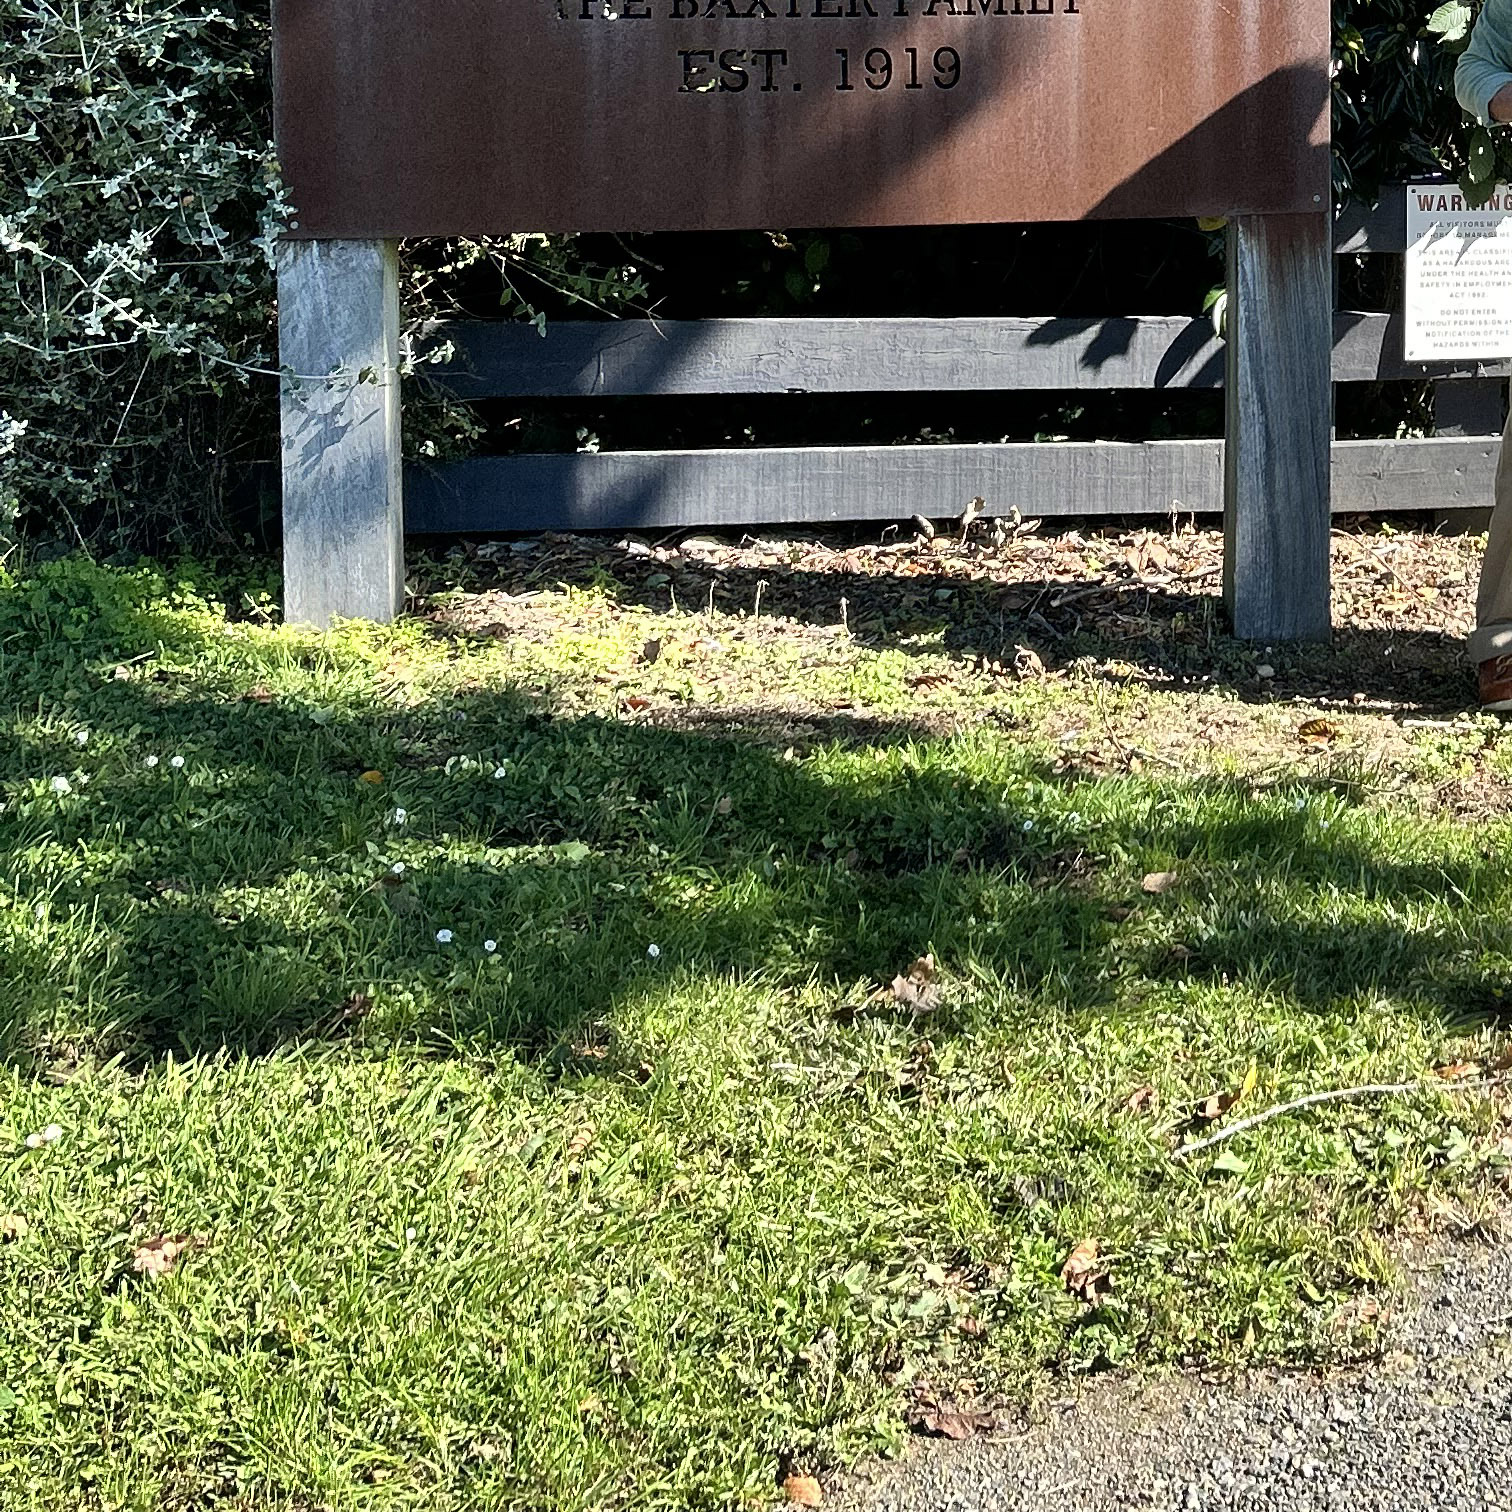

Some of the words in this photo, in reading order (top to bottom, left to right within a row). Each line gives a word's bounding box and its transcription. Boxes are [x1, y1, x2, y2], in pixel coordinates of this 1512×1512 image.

[677, 48, 802, 94] EST.
[834, 44, 963, 92] 1919
[1453, 308, 1469, 316] NOT
[1471, 308, 1497, 316] ENTER
[1433, 341, 1470, 349] HAZARDS
